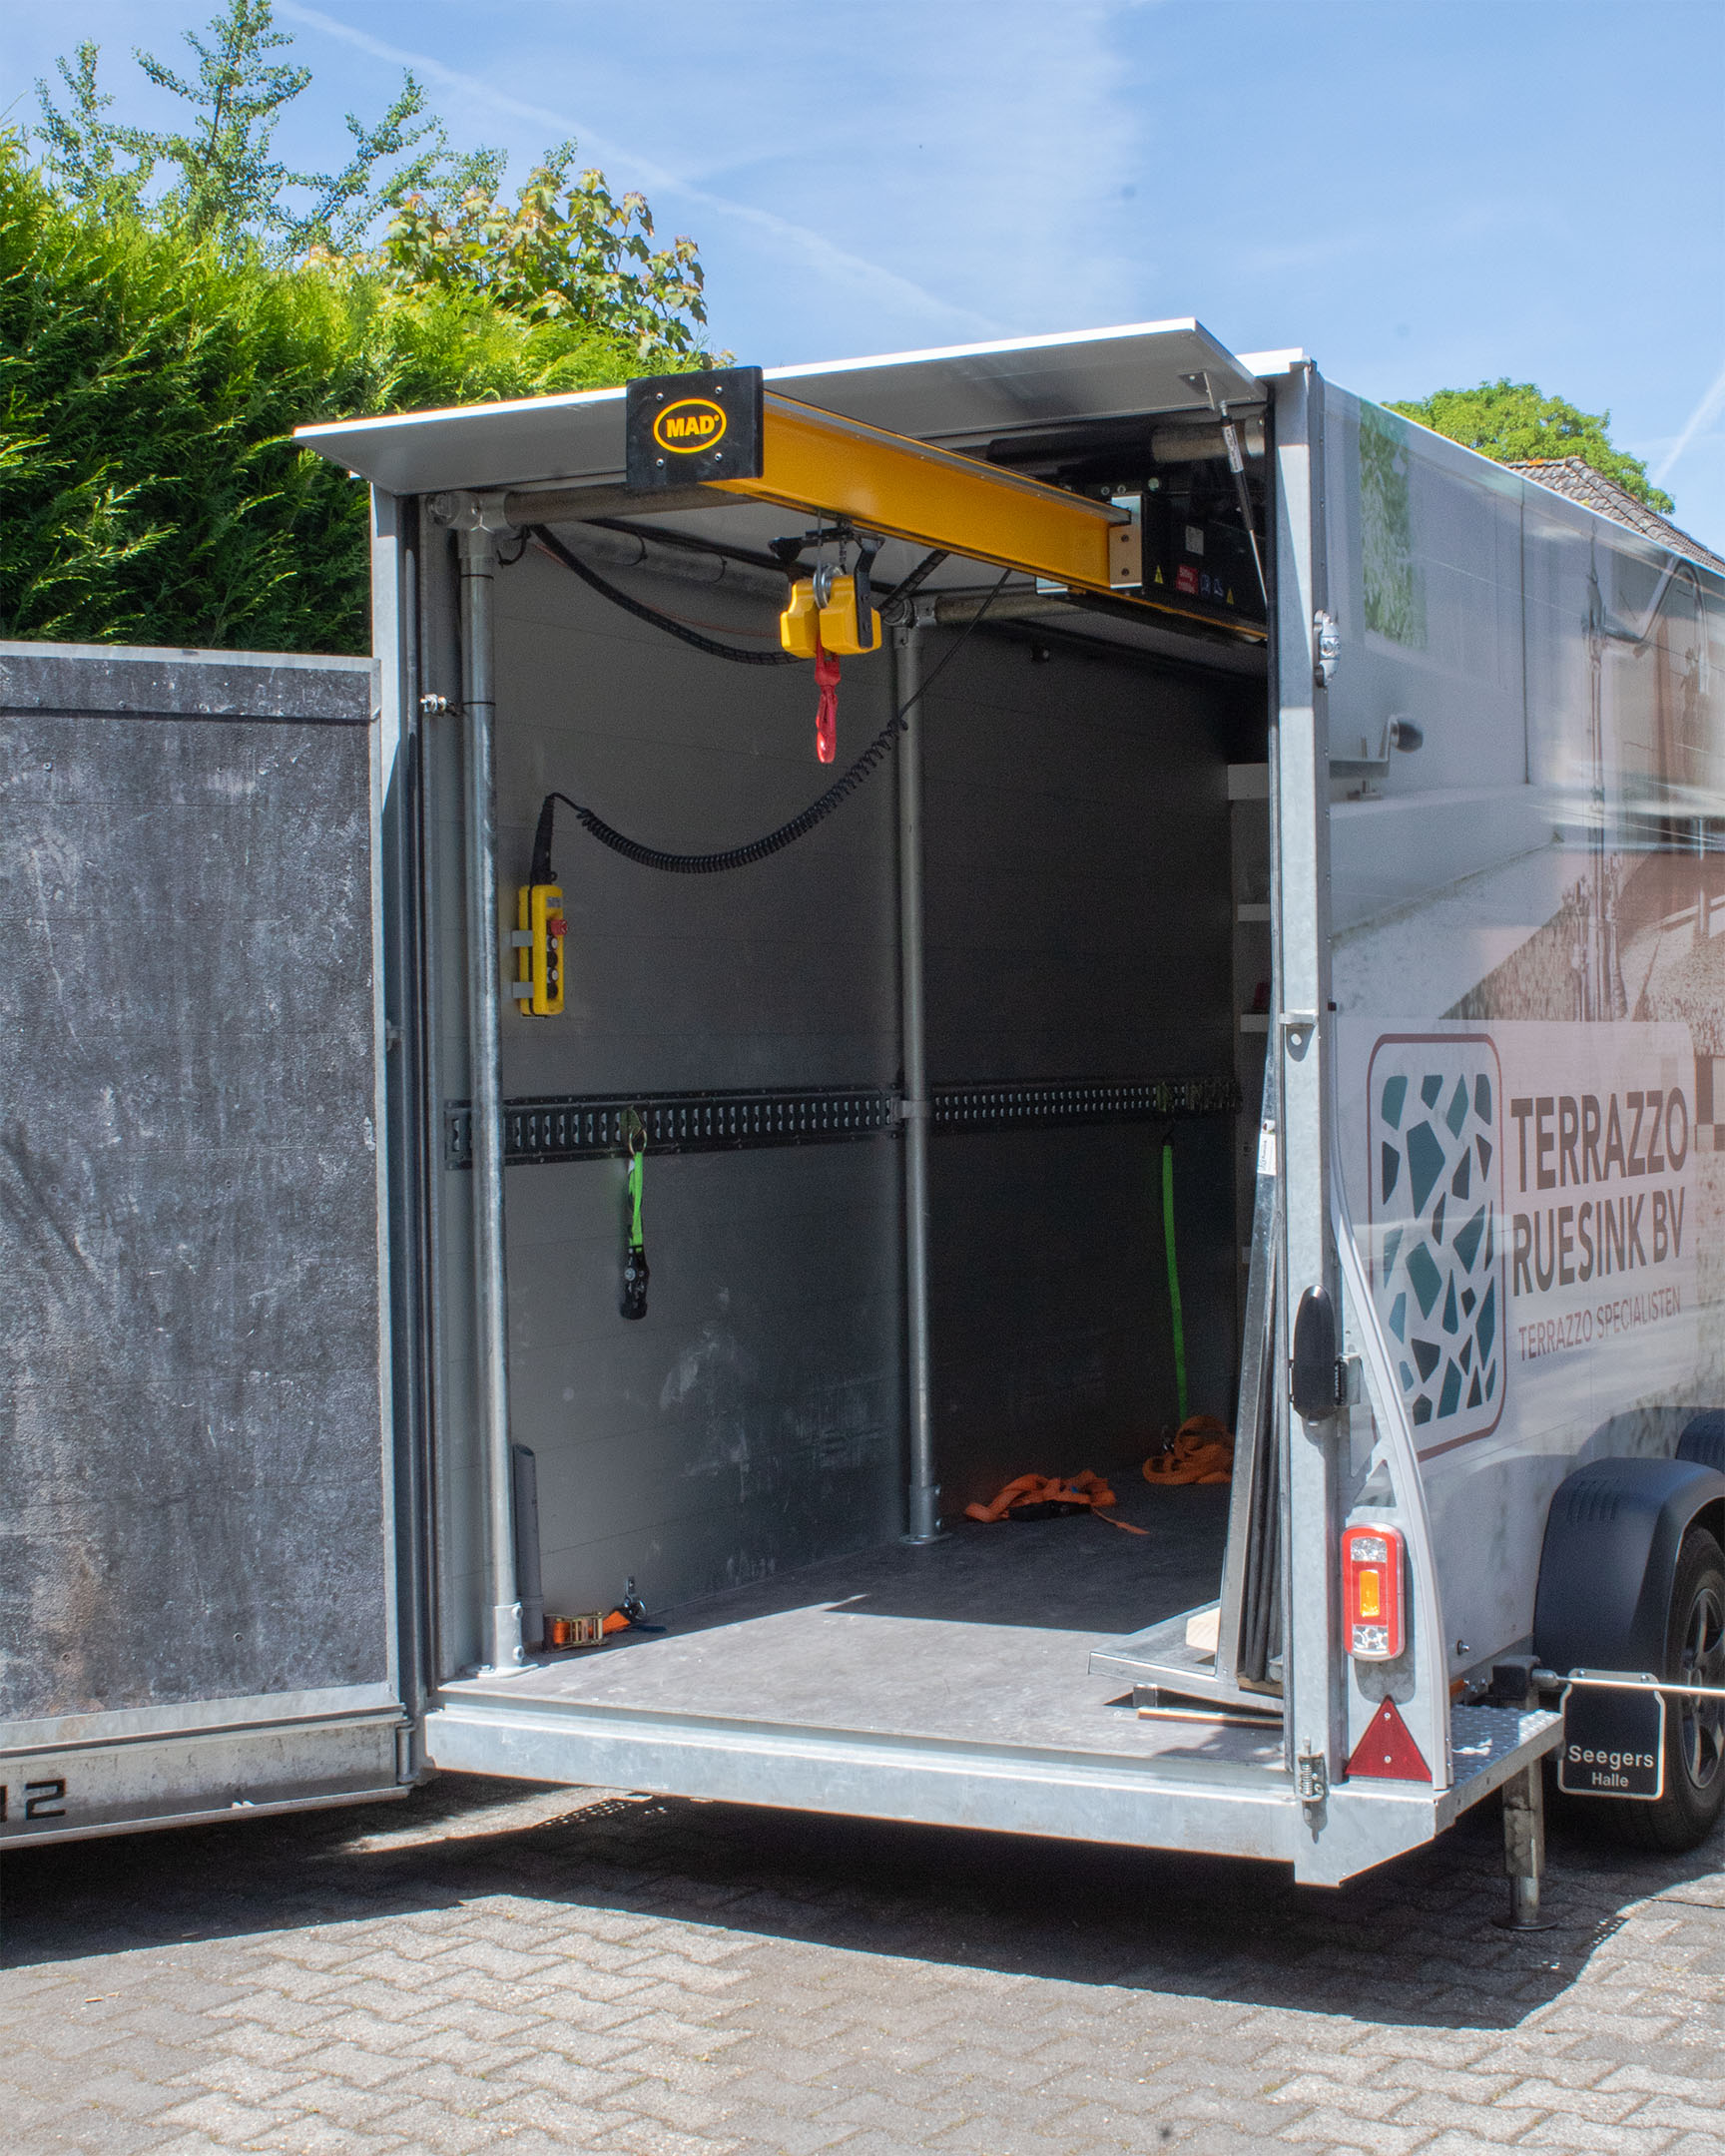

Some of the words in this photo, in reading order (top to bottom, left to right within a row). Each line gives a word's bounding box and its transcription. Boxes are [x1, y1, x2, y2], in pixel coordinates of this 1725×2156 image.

[666, 414, 715, 438] MAD
[1510, 1087, 1688, 1192] TERRAZZO
[1512, 1193, 1647, 1297] RUESINK
[1652, 1186, 1685, 1264] BV
[1518, 1309, 1593, 1360] TERRAZZO
[1596, 1286, 1681, 1339] SPECIALISTEN
[1568, 1745, 1654, 1771] Seegers
[1591, 1772, 1629, 1787] Halle
